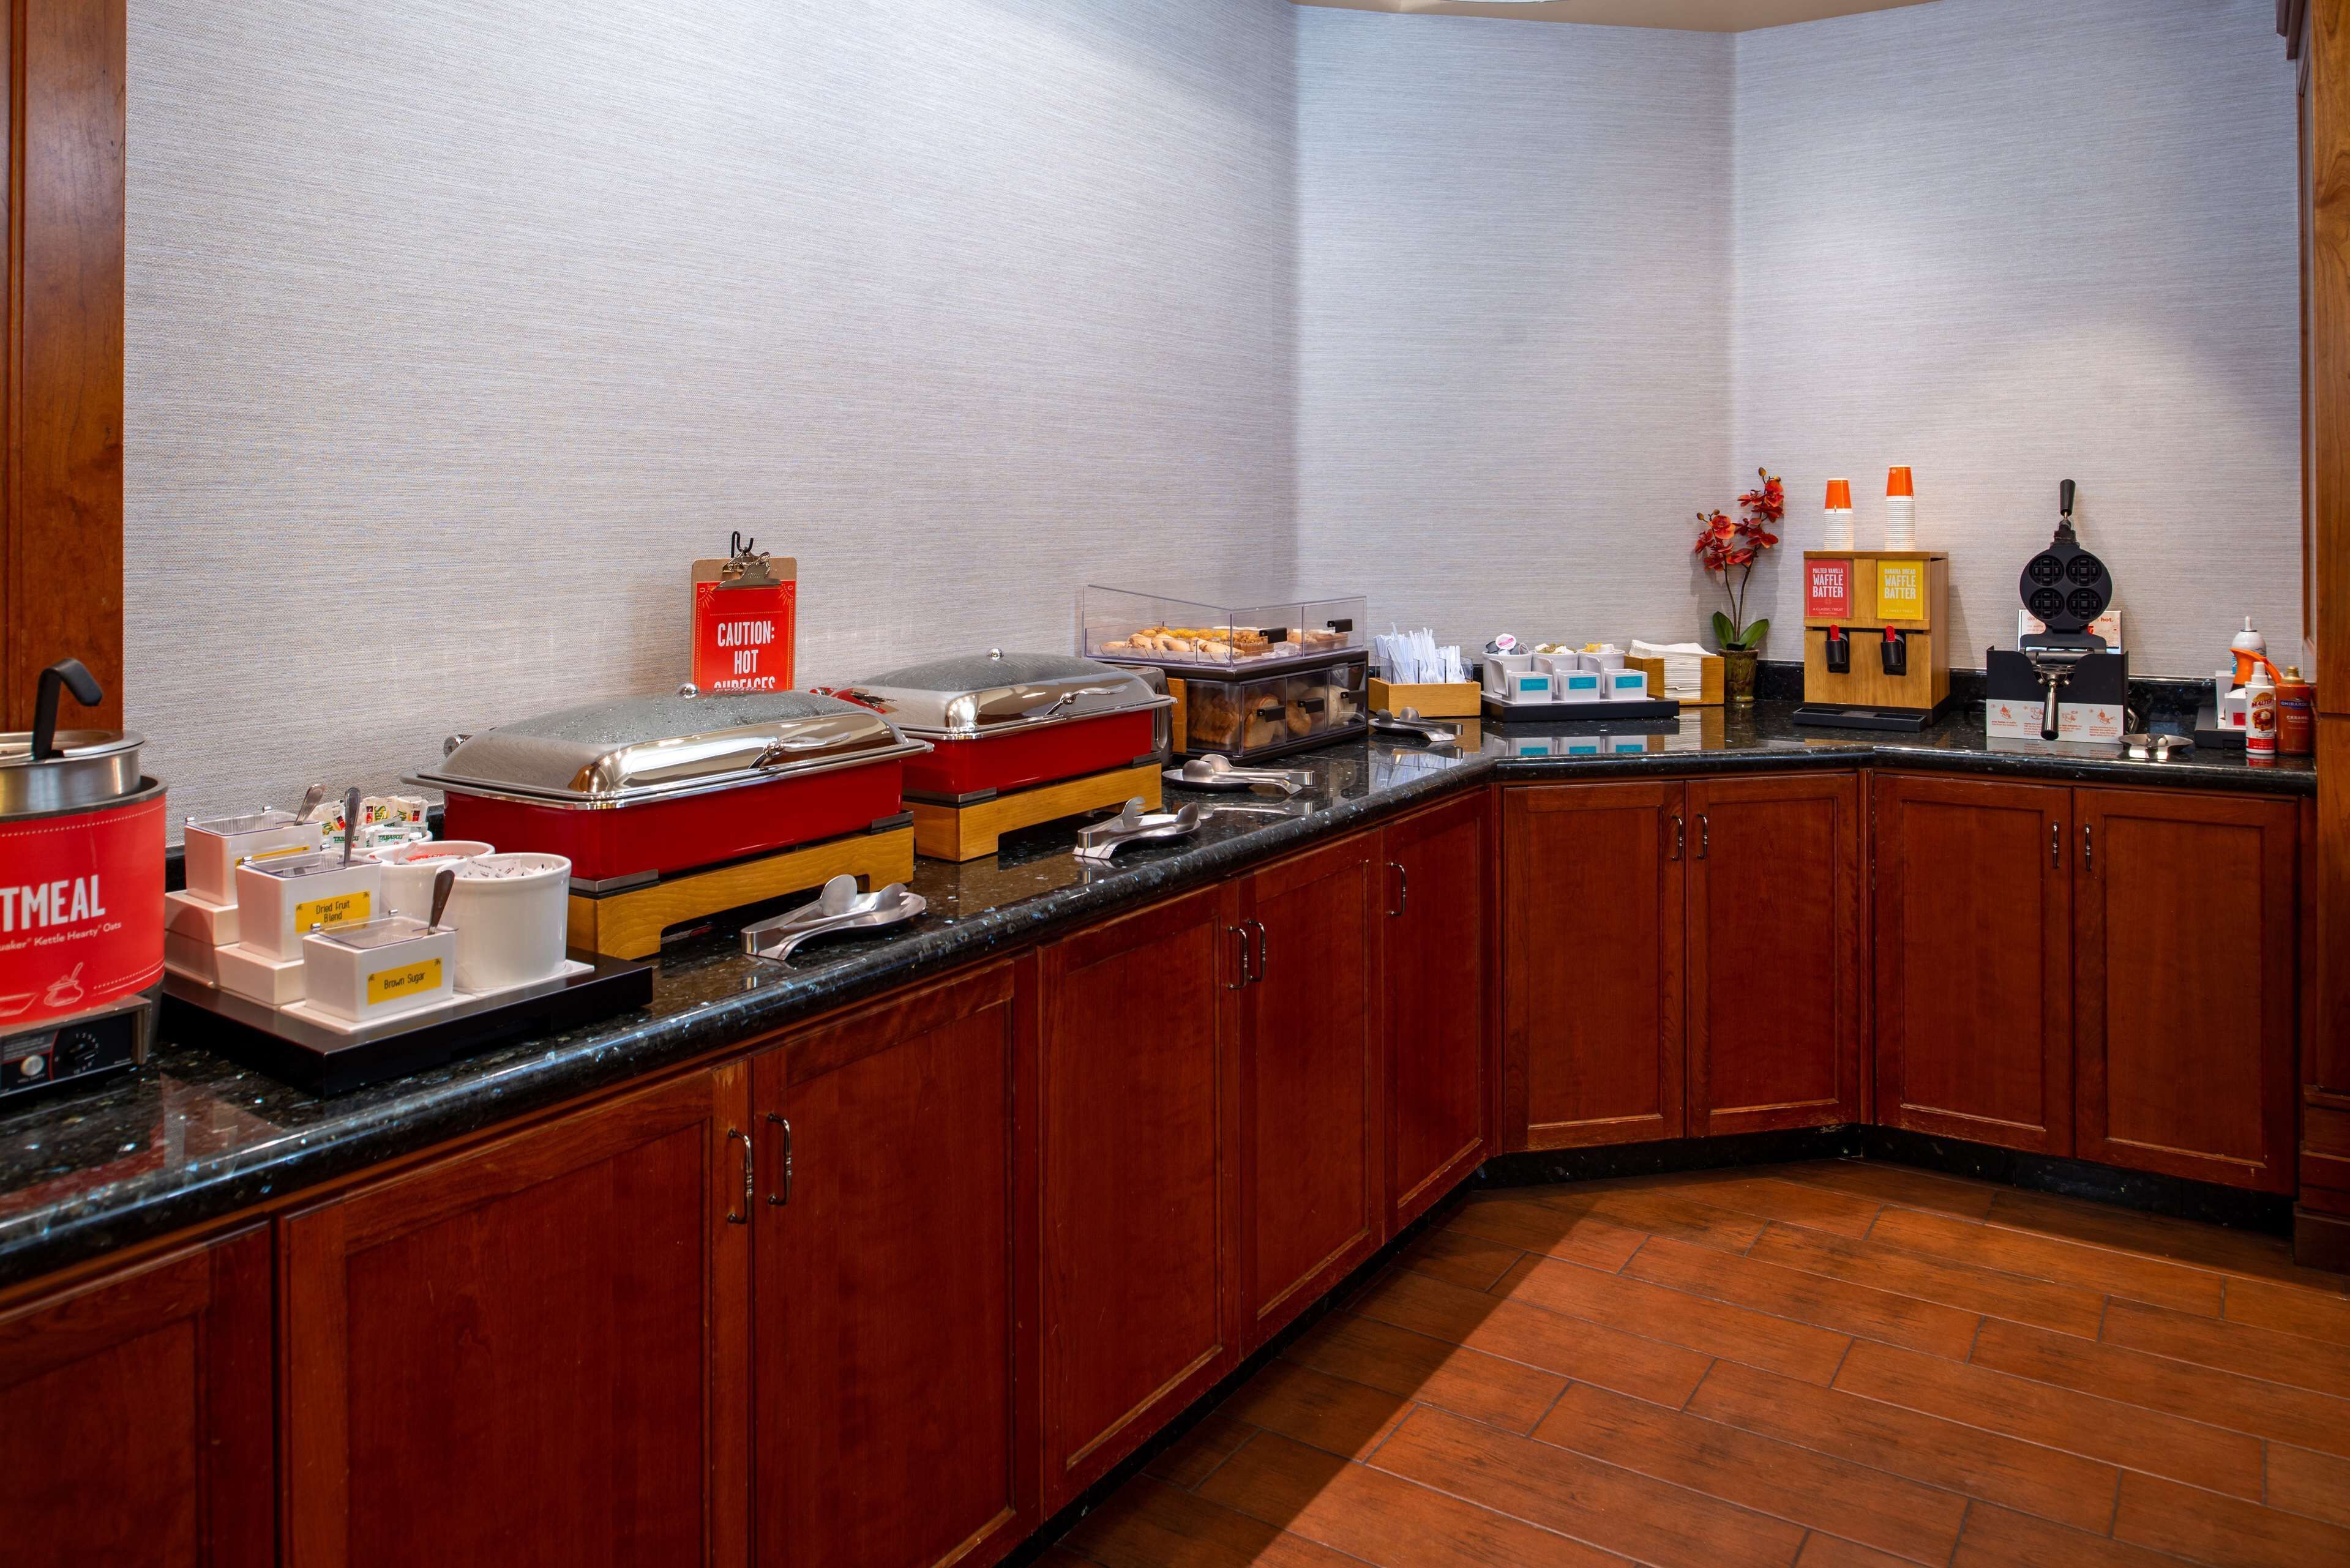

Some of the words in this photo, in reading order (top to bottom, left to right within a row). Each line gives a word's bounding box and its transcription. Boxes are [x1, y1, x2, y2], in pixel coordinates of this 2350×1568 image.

[1813, 574, 1844, 586] WAFFLE
[1884, 575, 1916, 587] WAFFLE
[1813, 586, 1843, 598] BATTER
[1884, 587, 1916, 599] BATTER
[717, 621, 774, 647] CAUTION:
[734, 649, 758, 674] HOT
[316, 903, 332, 915] Dried
[335, 900, 350, 911] Fruit
[324, 911, 342, 923] Blend
[34, 933, 64, 946] Kettle
[67, 928, 99, 941] Hearty
[103, 922, 122, 933] Oats
[384, 977, 405, 990] Brown
[408, 972, 425, 985] Sugar
